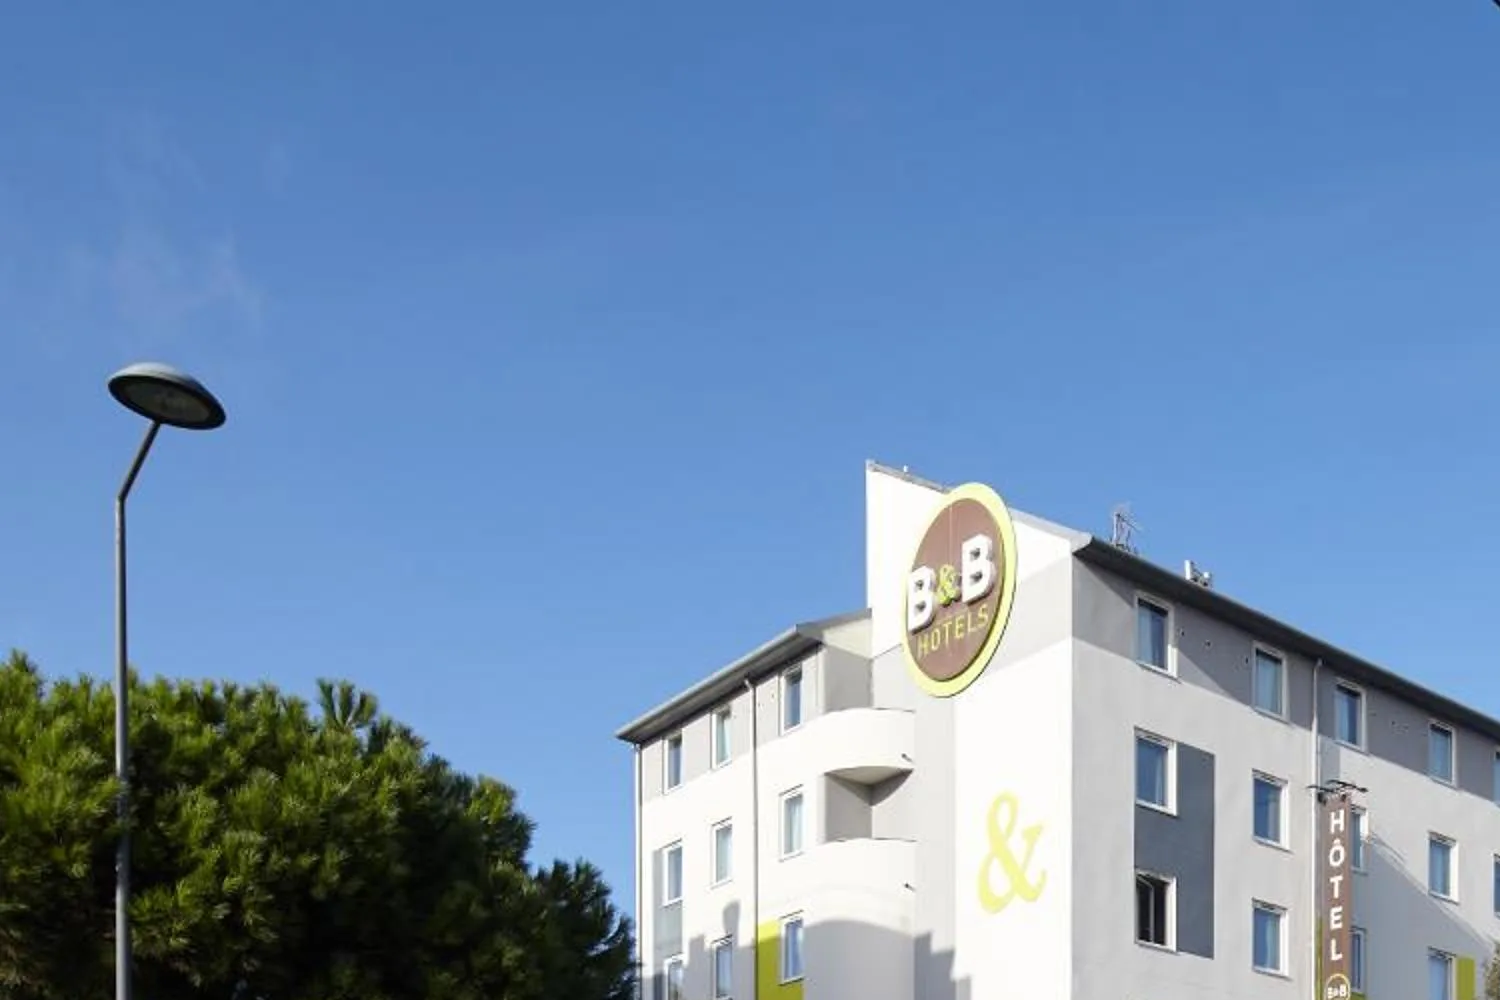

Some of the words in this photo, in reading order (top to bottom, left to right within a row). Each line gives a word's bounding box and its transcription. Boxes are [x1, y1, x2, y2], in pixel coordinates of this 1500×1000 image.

[907, 534, 995, 634] B&B
[917, 604, 989, 658] HOTELS
[978, 789, 1047, 915] &
[1328, 810, 1345, 961] HÔTEL
